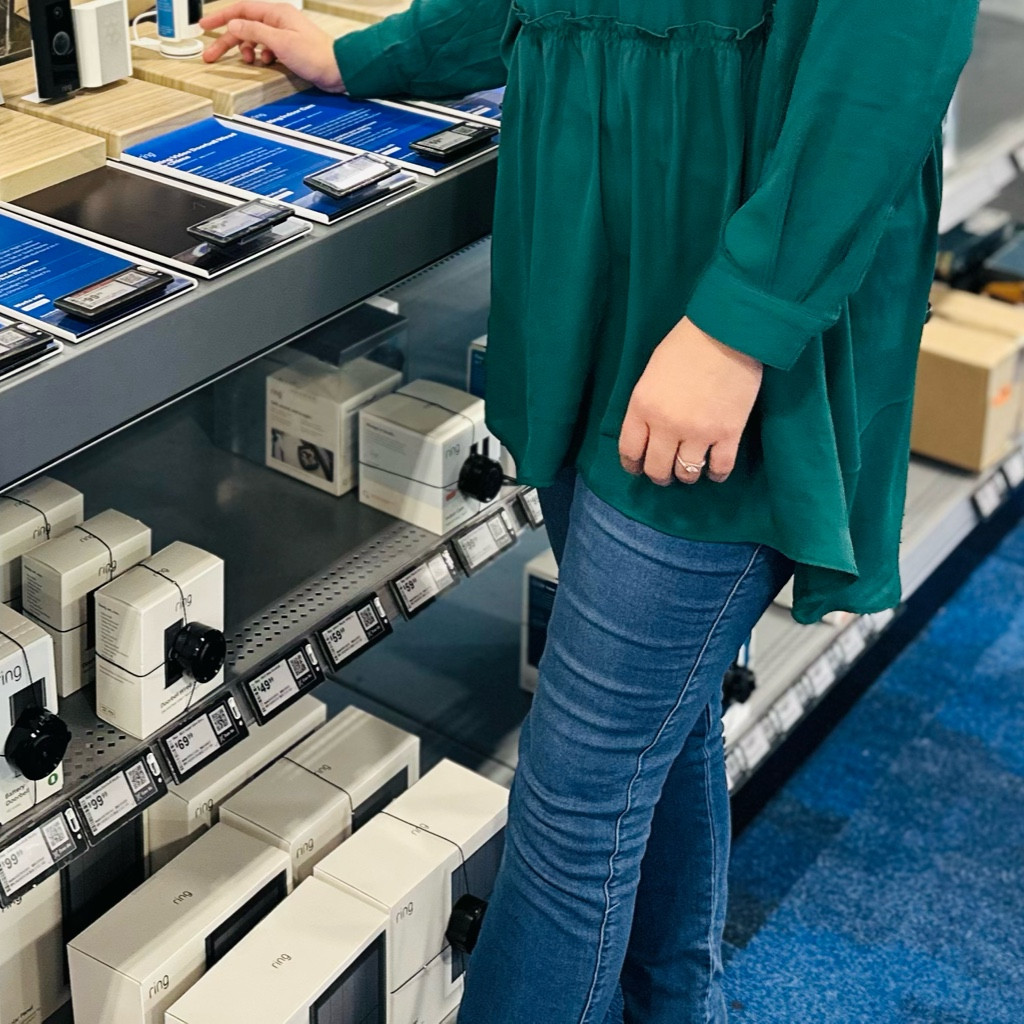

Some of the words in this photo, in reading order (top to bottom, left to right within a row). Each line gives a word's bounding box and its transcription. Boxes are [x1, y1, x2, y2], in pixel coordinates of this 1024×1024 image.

[195, 798, 214, 819] ring
[296, 838, 314, 859] ring
[173, 891, 193, 905] ring
[396, 902, 413, 924] ring
[272, 953, 292, 969] ring
[149, 975, 170, 999] ring
